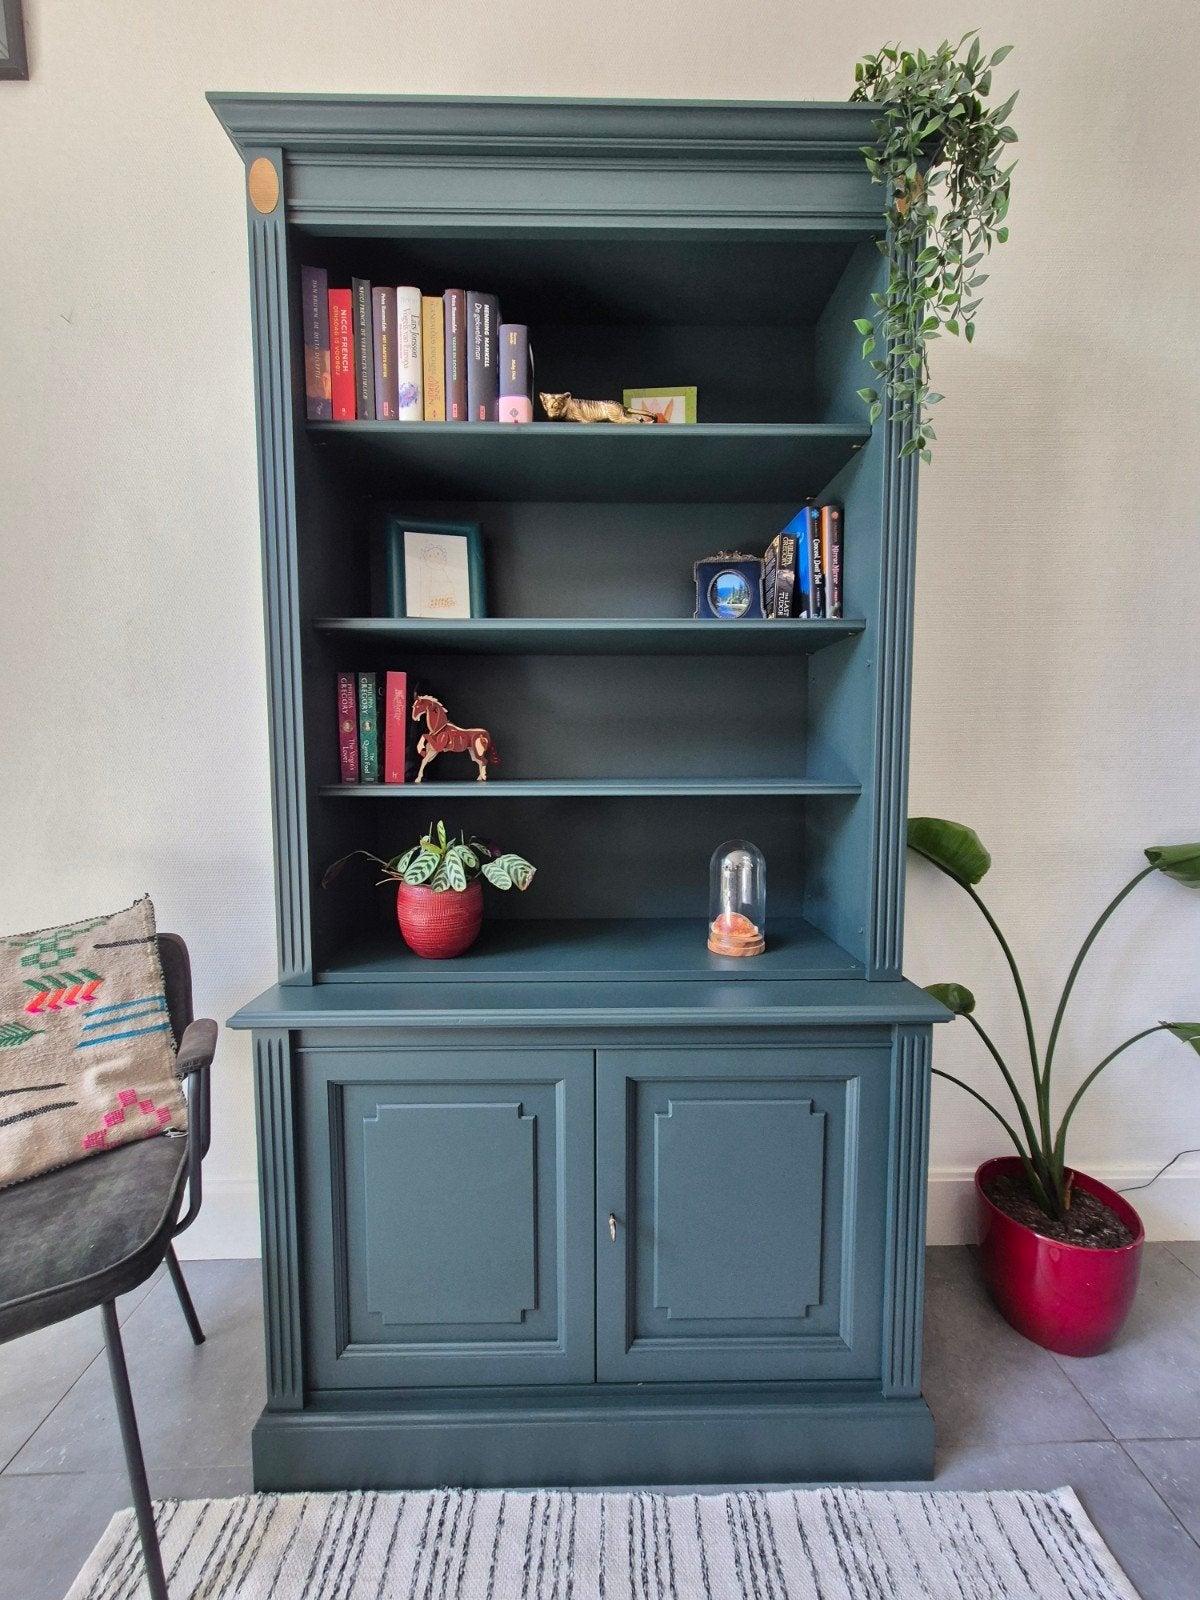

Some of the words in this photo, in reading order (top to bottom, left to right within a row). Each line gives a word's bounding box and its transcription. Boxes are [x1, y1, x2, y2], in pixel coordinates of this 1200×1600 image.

[475, 303, 482, 314] De
[410, 314, 420, 330] Lars
[474, 314, 482, 344] gekwelde
[410, 331, 420, 359] Jonsson
[348, 750, 356, 770] Virgin's
[362, 740, 370, 762] Queen's
